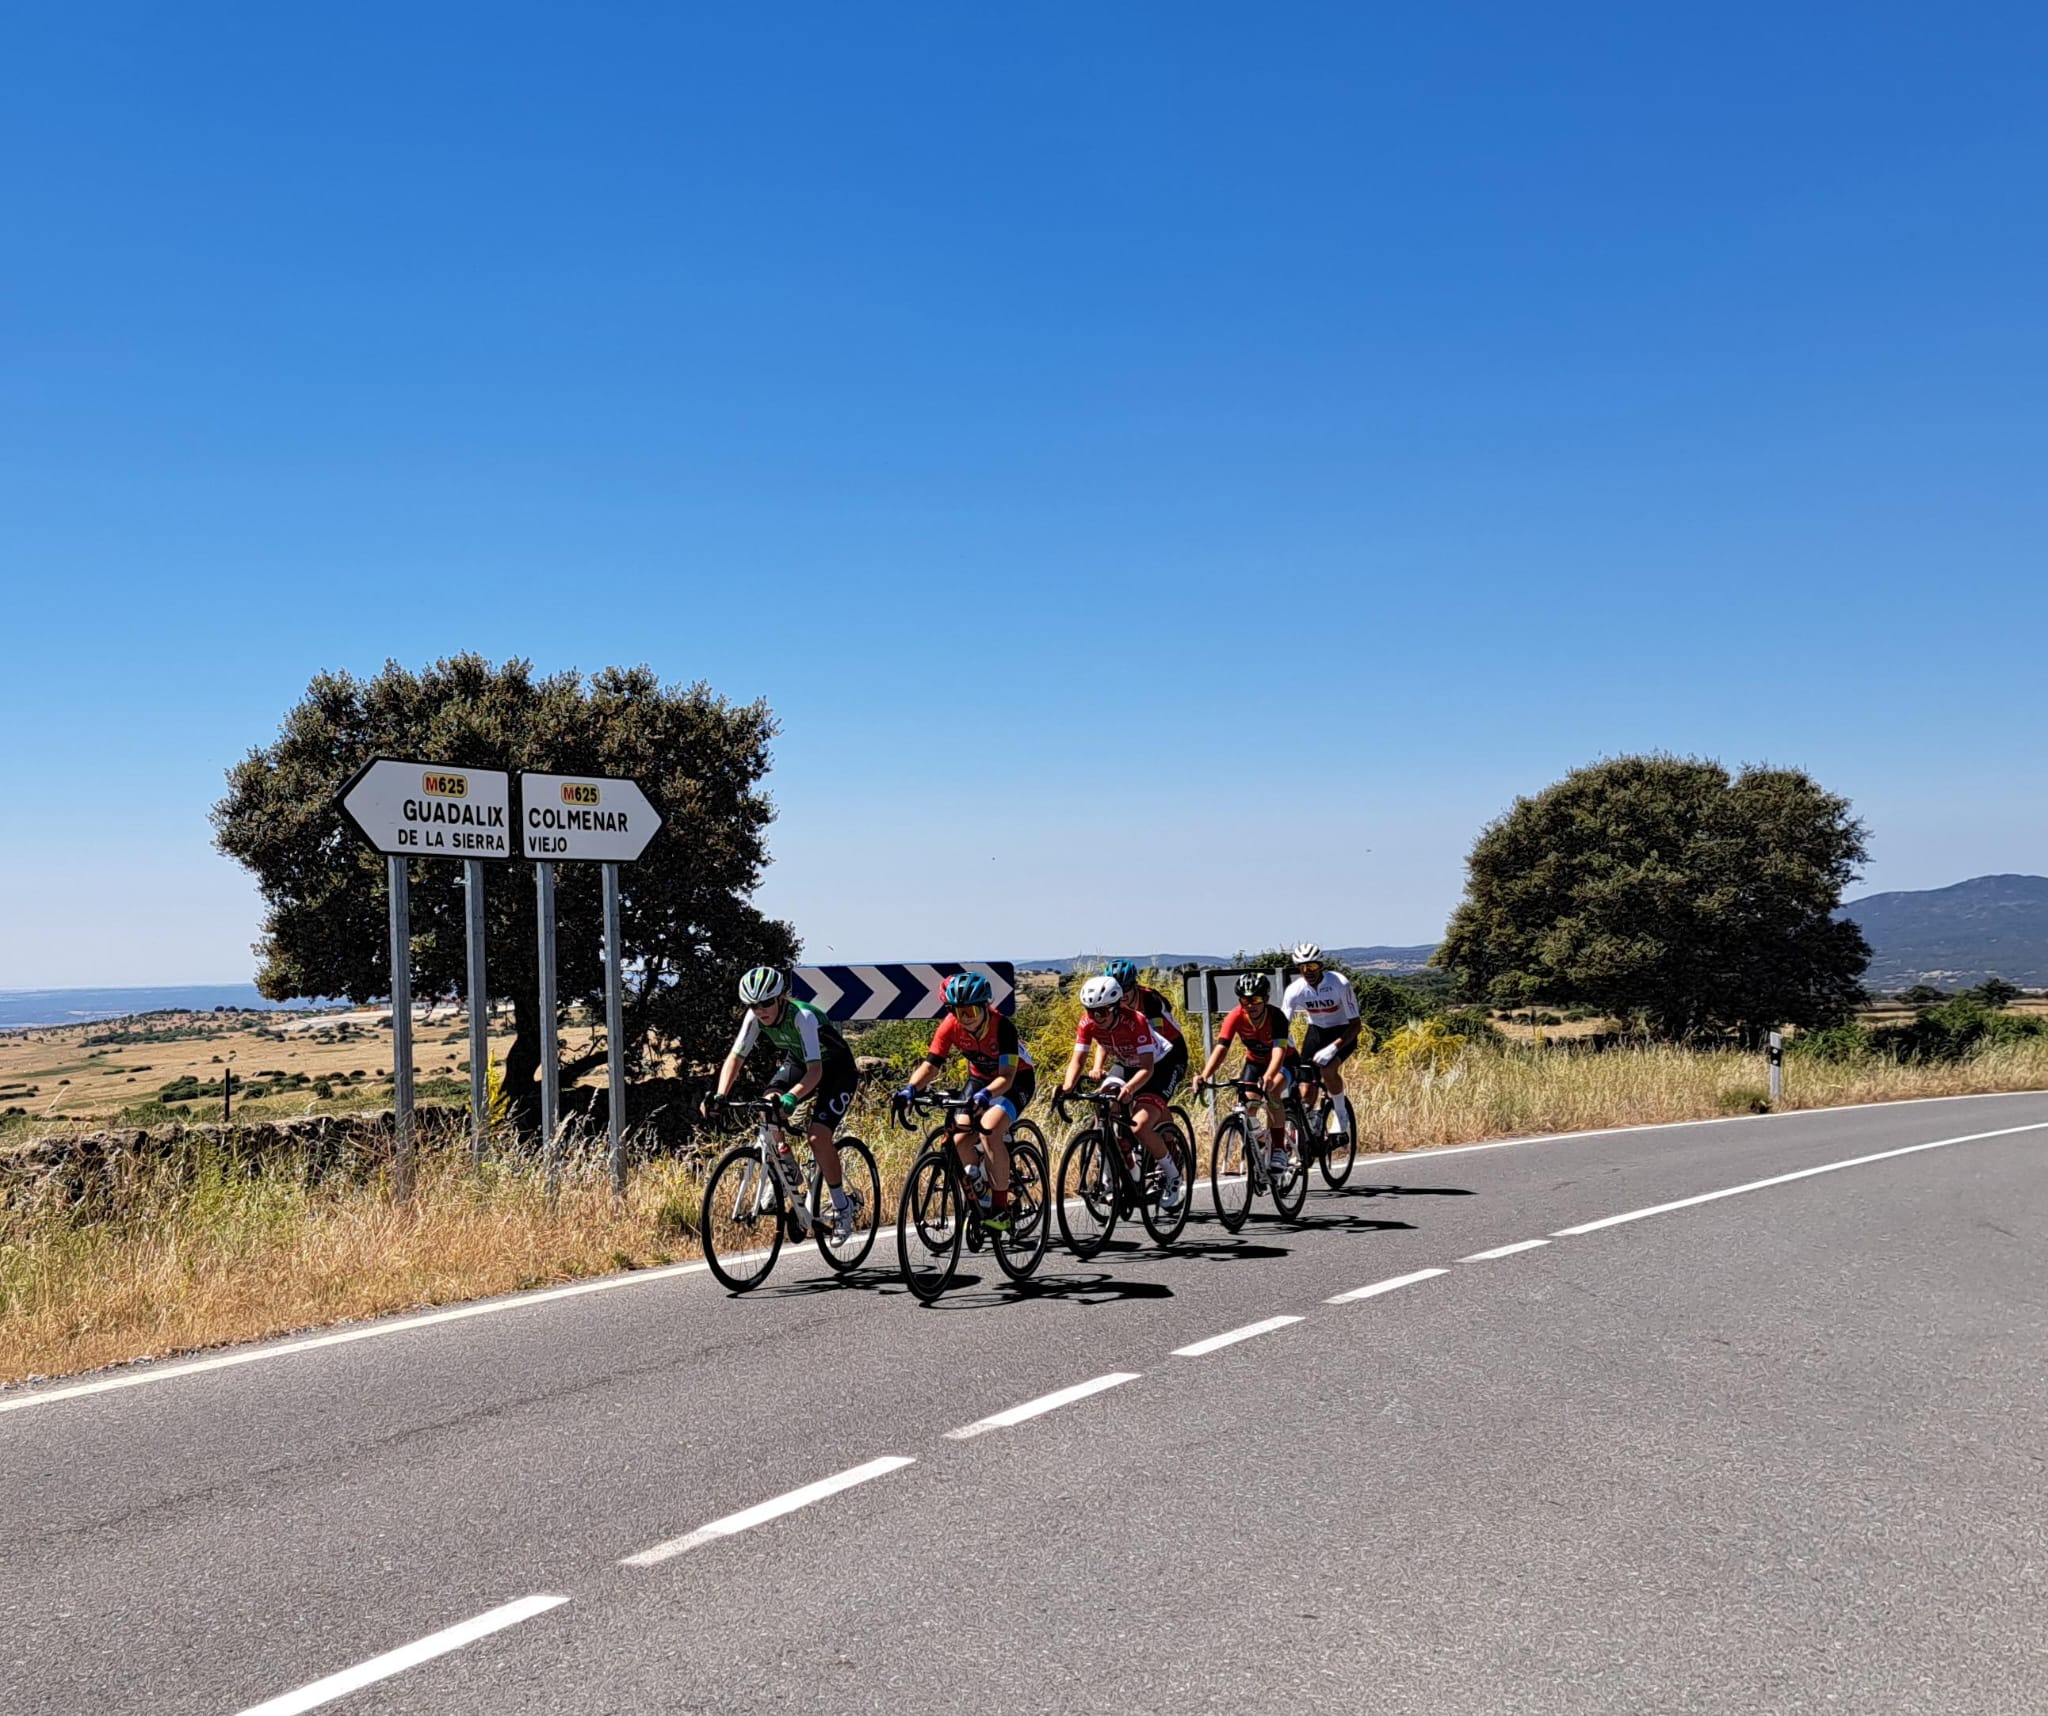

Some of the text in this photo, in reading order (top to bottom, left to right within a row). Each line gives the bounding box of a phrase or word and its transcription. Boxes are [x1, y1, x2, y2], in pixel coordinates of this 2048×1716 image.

[425, 776, 465, 795] M625
[563, 786, 598, 803] M625
[403, 799, 505, 828] GUADALIX
[528, 807, 629, 833] COLMENAR
[397, 828, 506, 851] DE LA SIERRA
[528, 836, 568, 853] VIEJO
